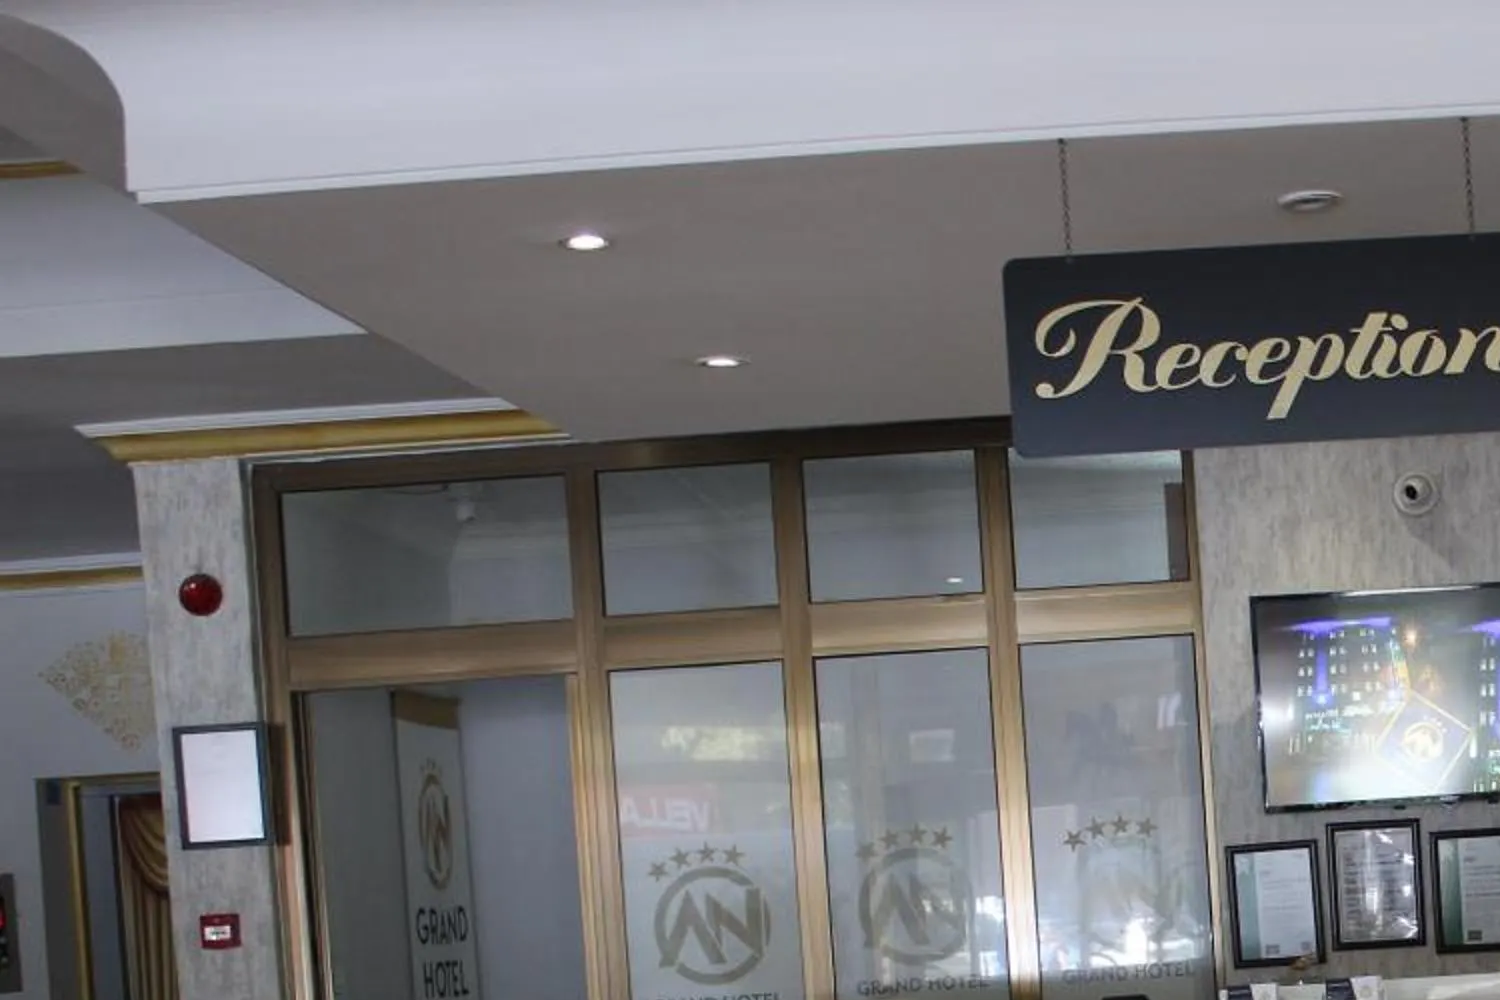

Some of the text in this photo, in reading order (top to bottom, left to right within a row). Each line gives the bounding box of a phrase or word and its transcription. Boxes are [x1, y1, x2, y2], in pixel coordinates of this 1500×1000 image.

[416, 905, 469, 945] GRAND
[423, 960, 470, 999] HOTEL
[857, 974, 992, 998] GRAND HOTEL
[1135, 961, 1197, 981] HOTEL
